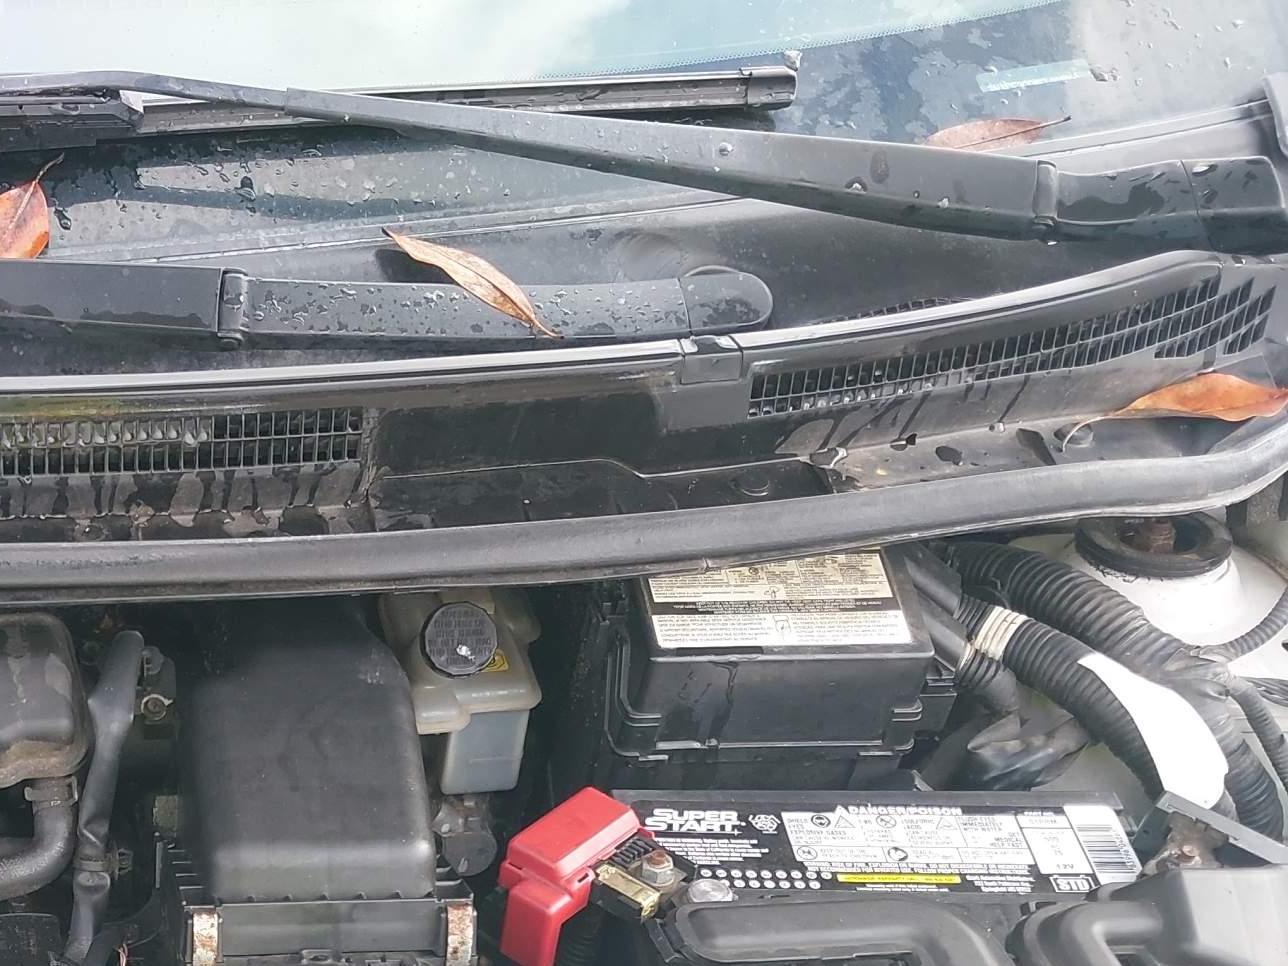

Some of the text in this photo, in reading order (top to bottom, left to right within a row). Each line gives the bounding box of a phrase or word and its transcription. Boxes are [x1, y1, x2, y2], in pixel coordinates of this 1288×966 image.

[652, 808, 738, 821] SUPER
[644, 816, 741, 832] START
[1057, 878, 1089, 890] STD
